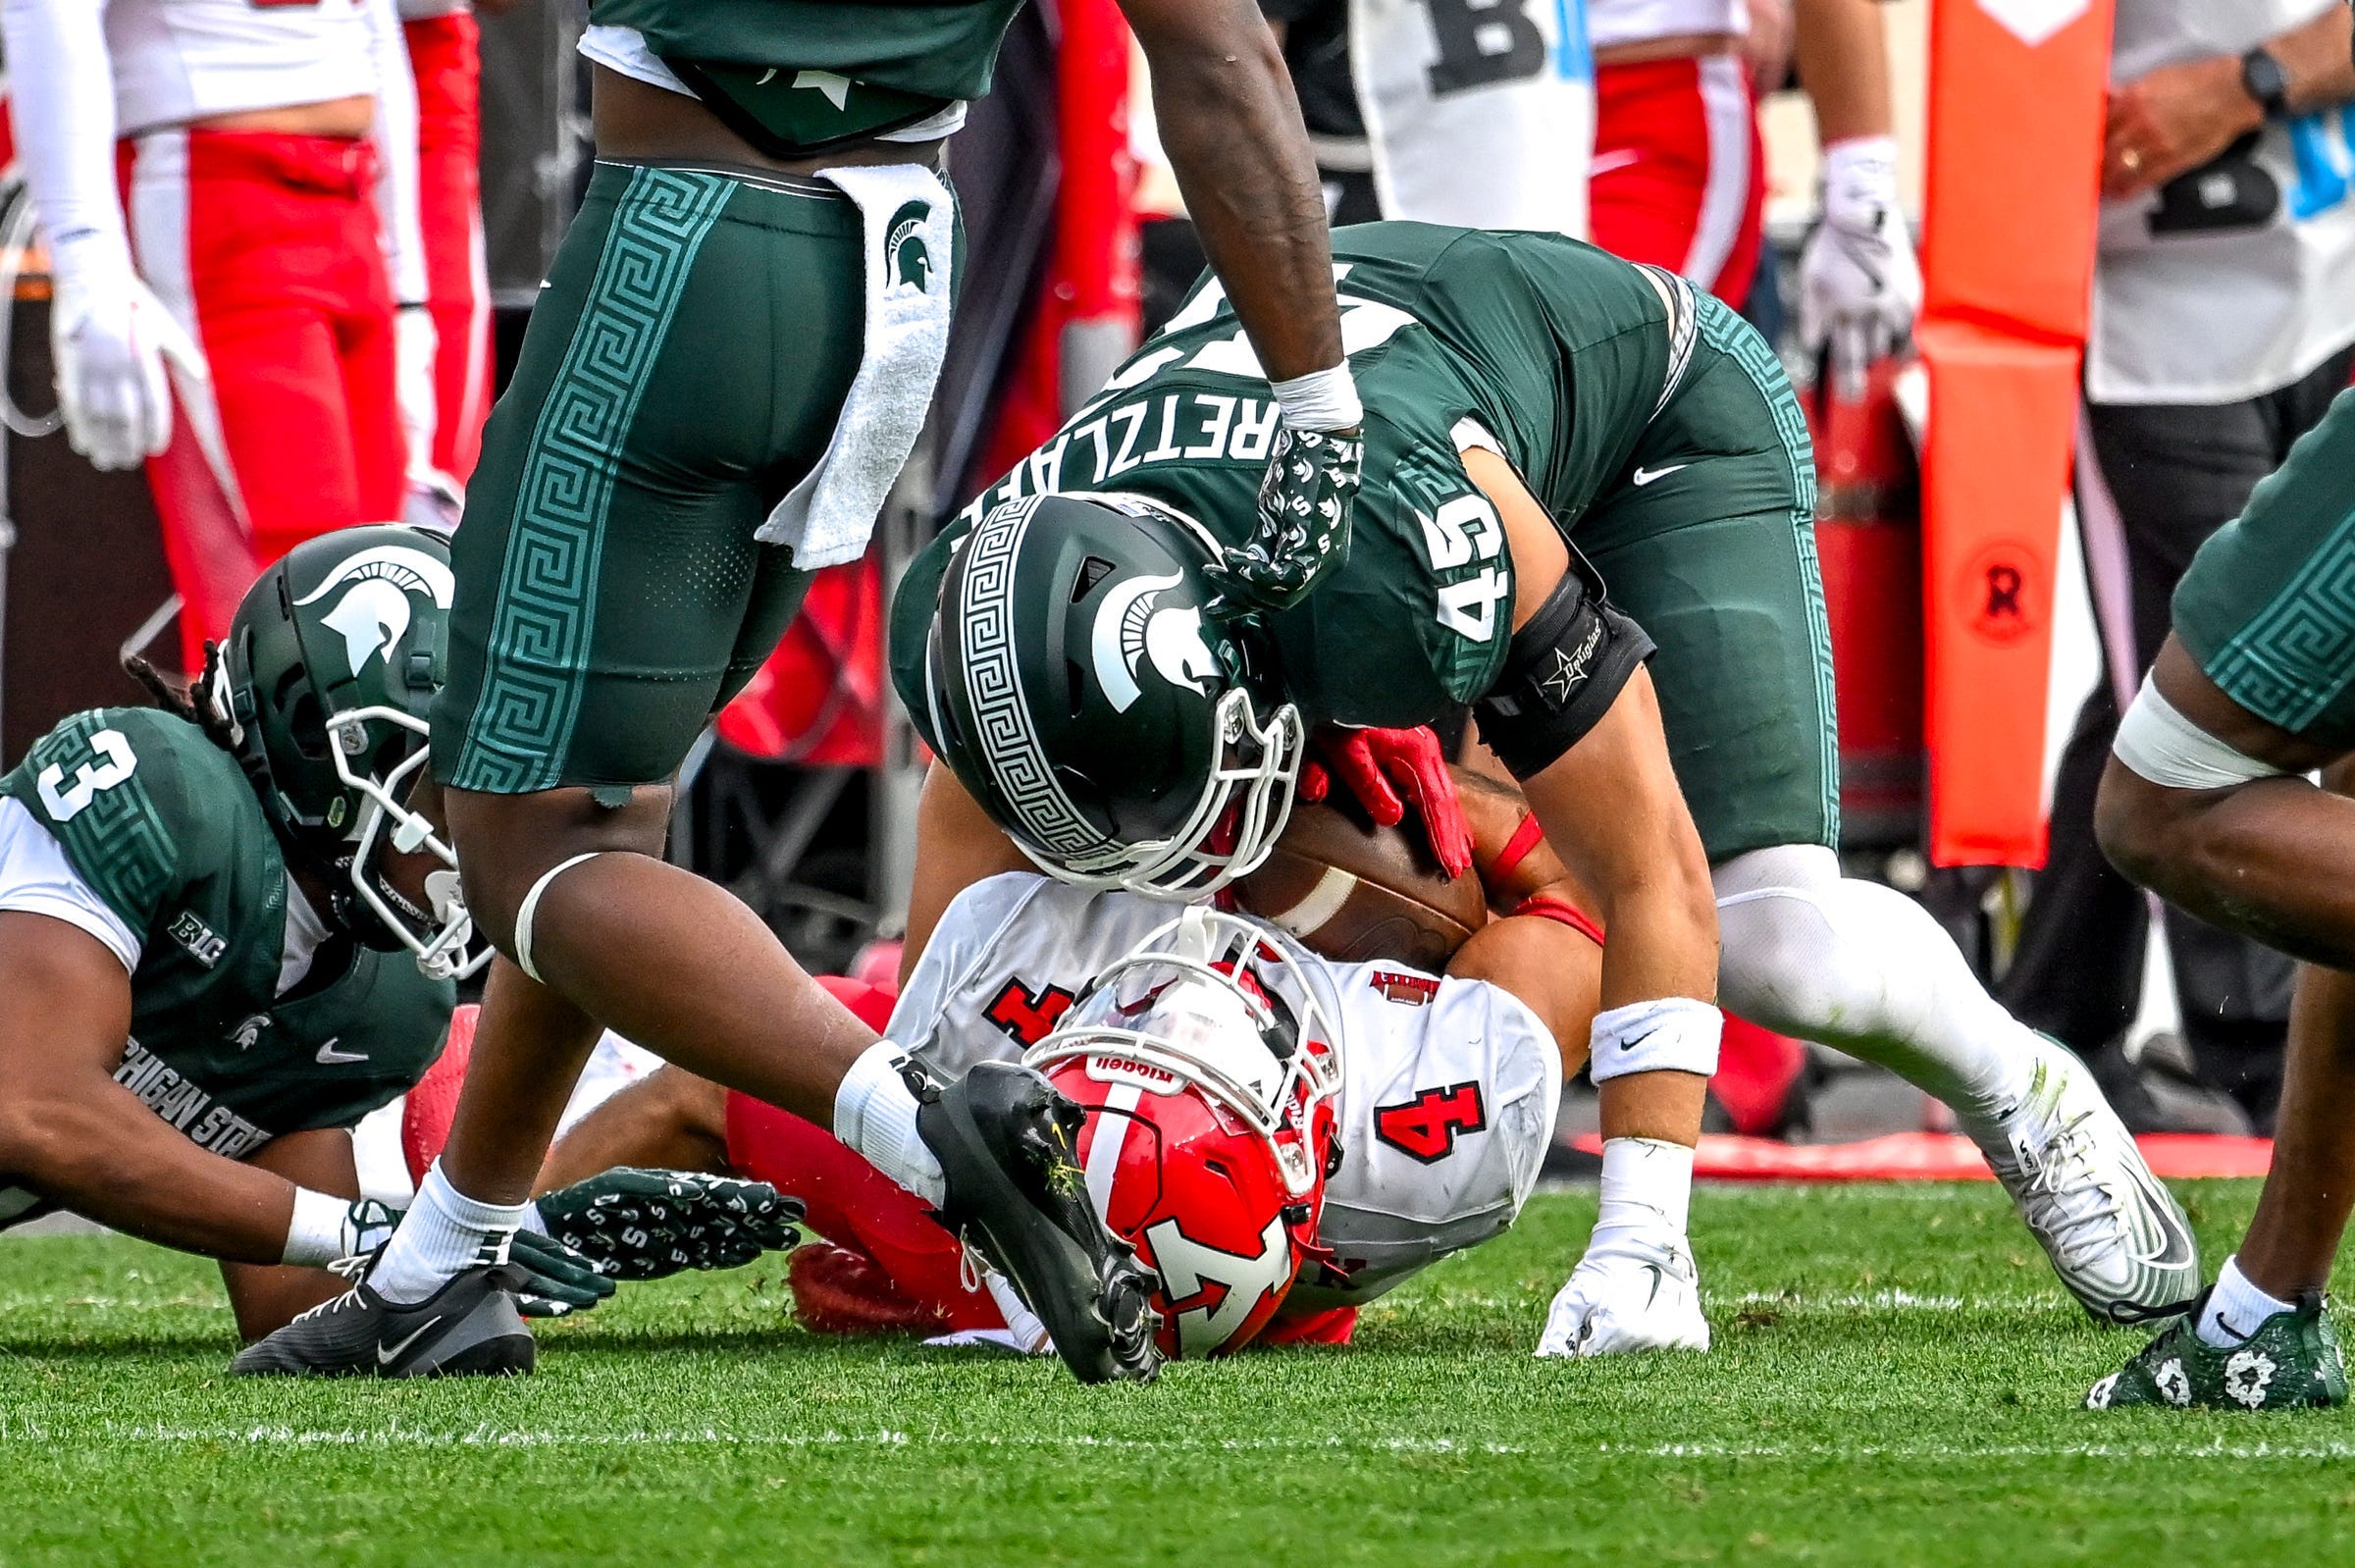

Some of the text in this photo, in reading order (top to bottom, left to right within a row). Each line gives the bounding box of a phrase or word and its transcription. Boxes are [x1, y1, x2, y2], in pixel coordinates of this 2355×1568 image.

[1414, 494, 1509, 643] 45
[1563, 617, 1601, 680] Douglas
[37, 729, 138, 822] 3
[1374, 1079, 1488, 1166] 4
